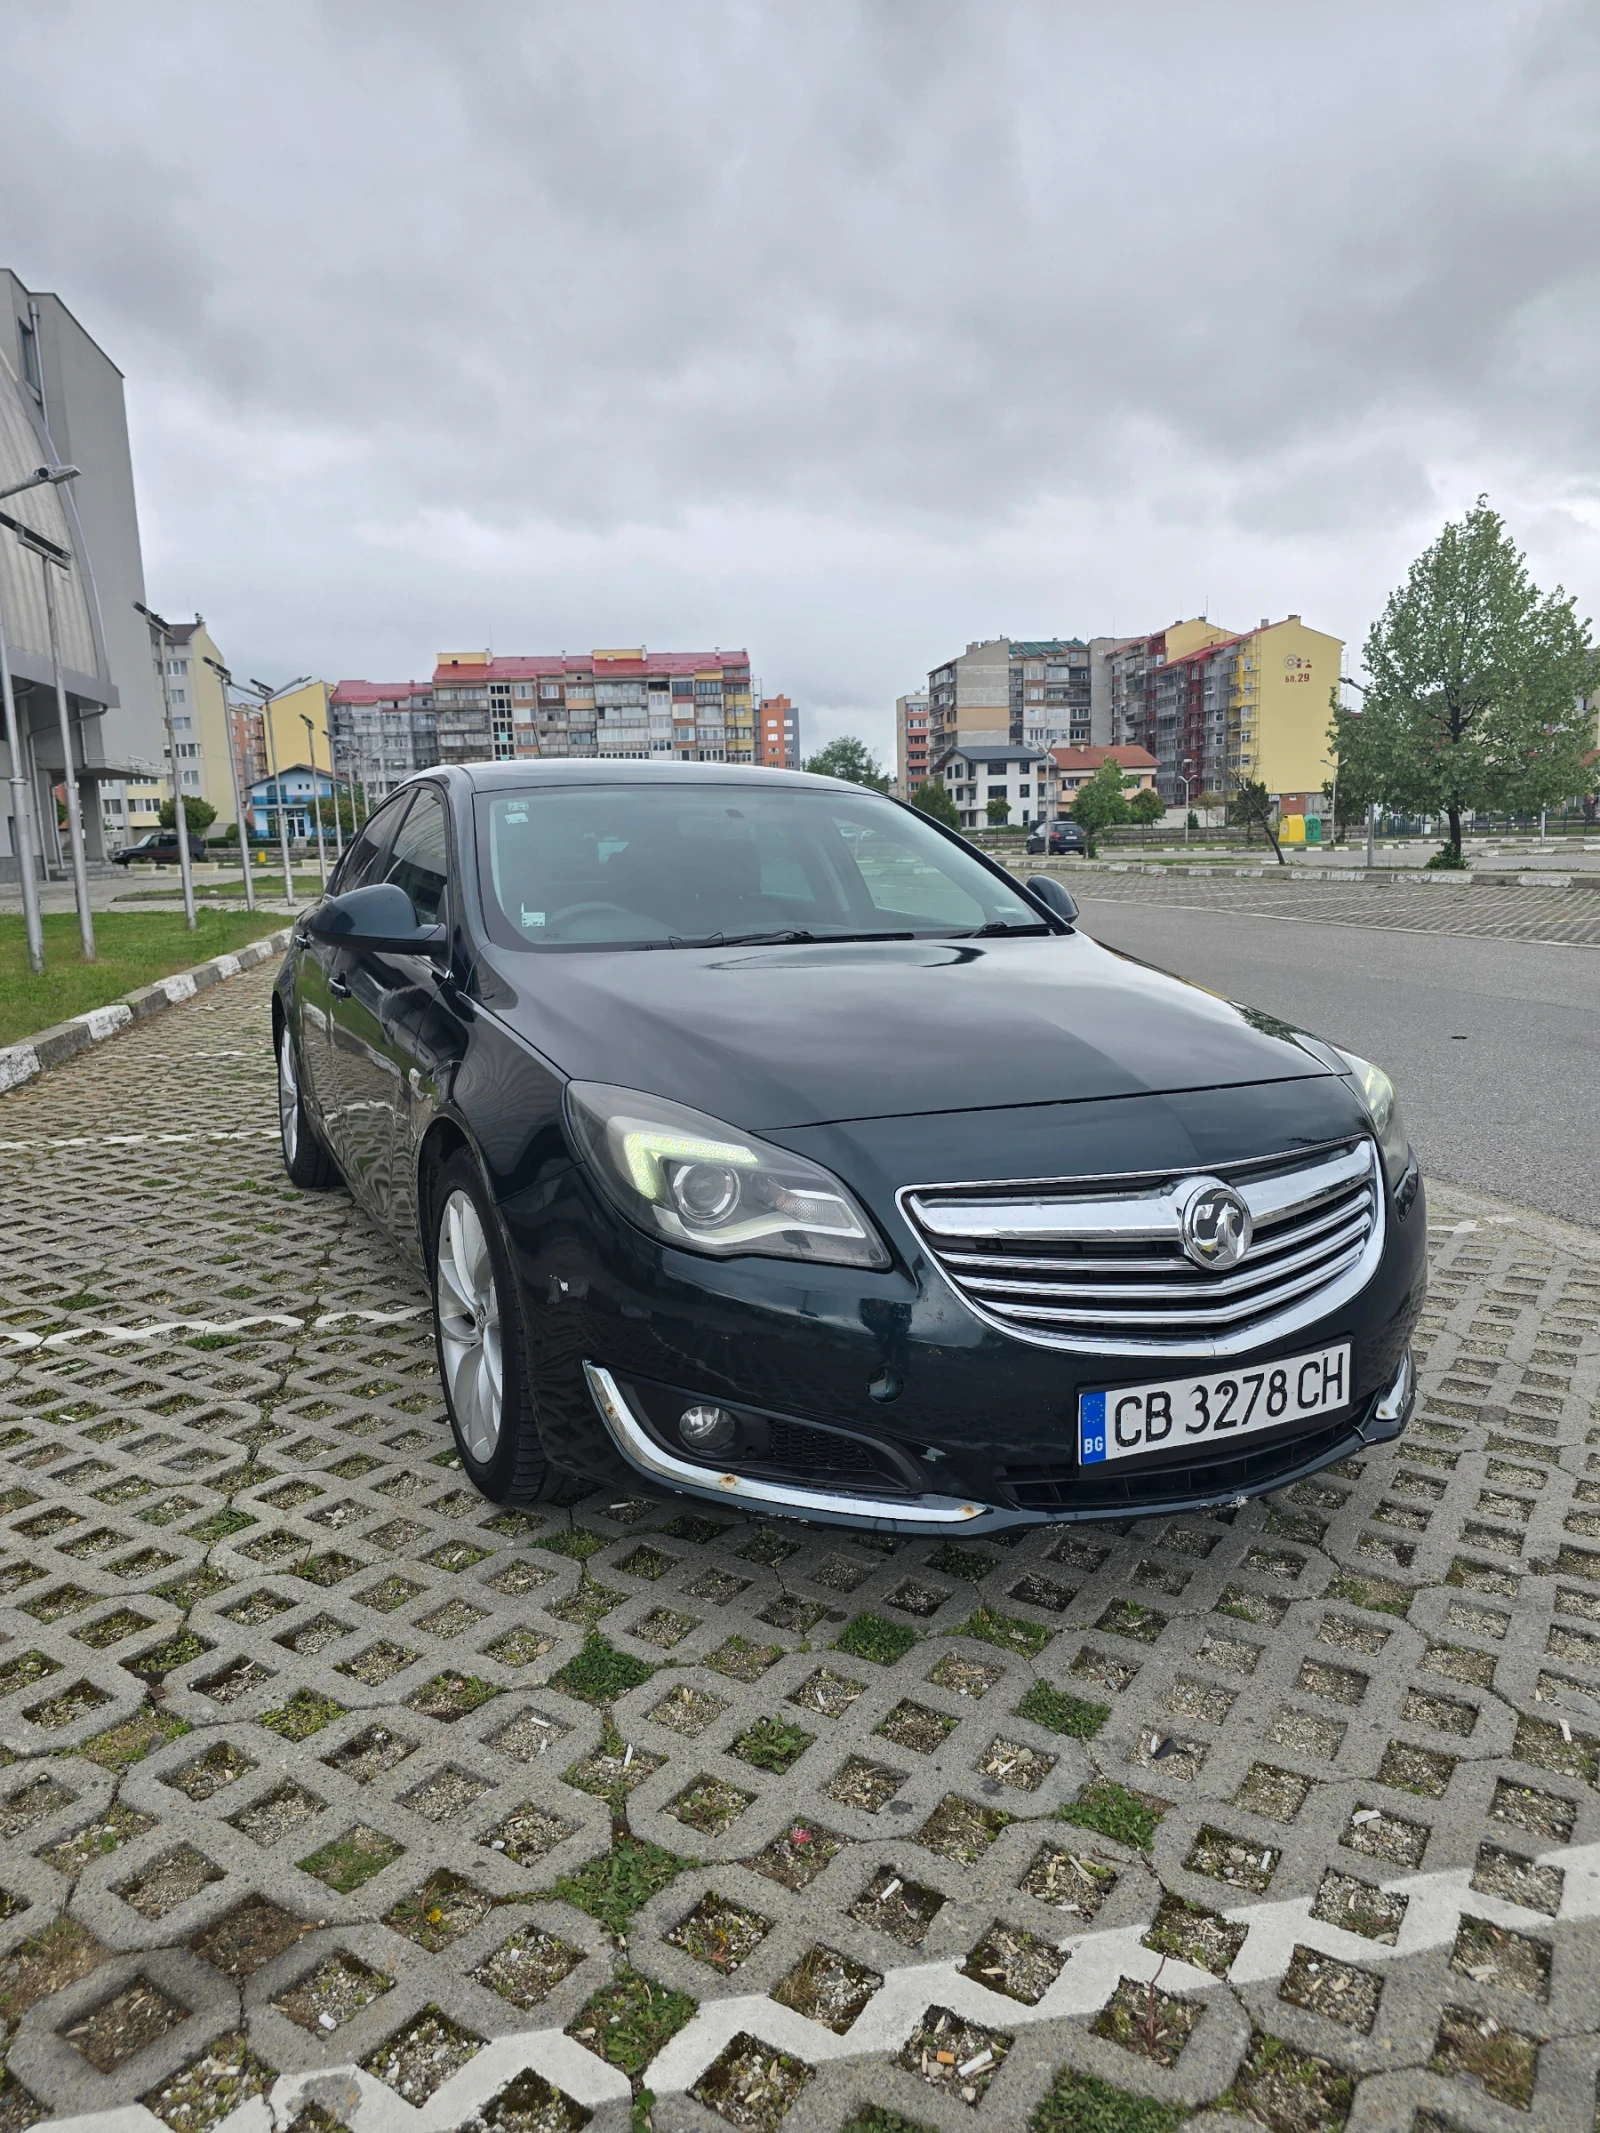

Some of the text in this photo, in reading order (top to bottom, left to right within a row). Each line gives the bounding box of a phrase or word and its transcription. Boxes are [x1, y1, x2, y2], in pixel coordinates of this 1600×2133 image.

[1114, 1352, 1344, 1448] CB 3278 CH
[1083, 1436, 1104, 1455] BG
